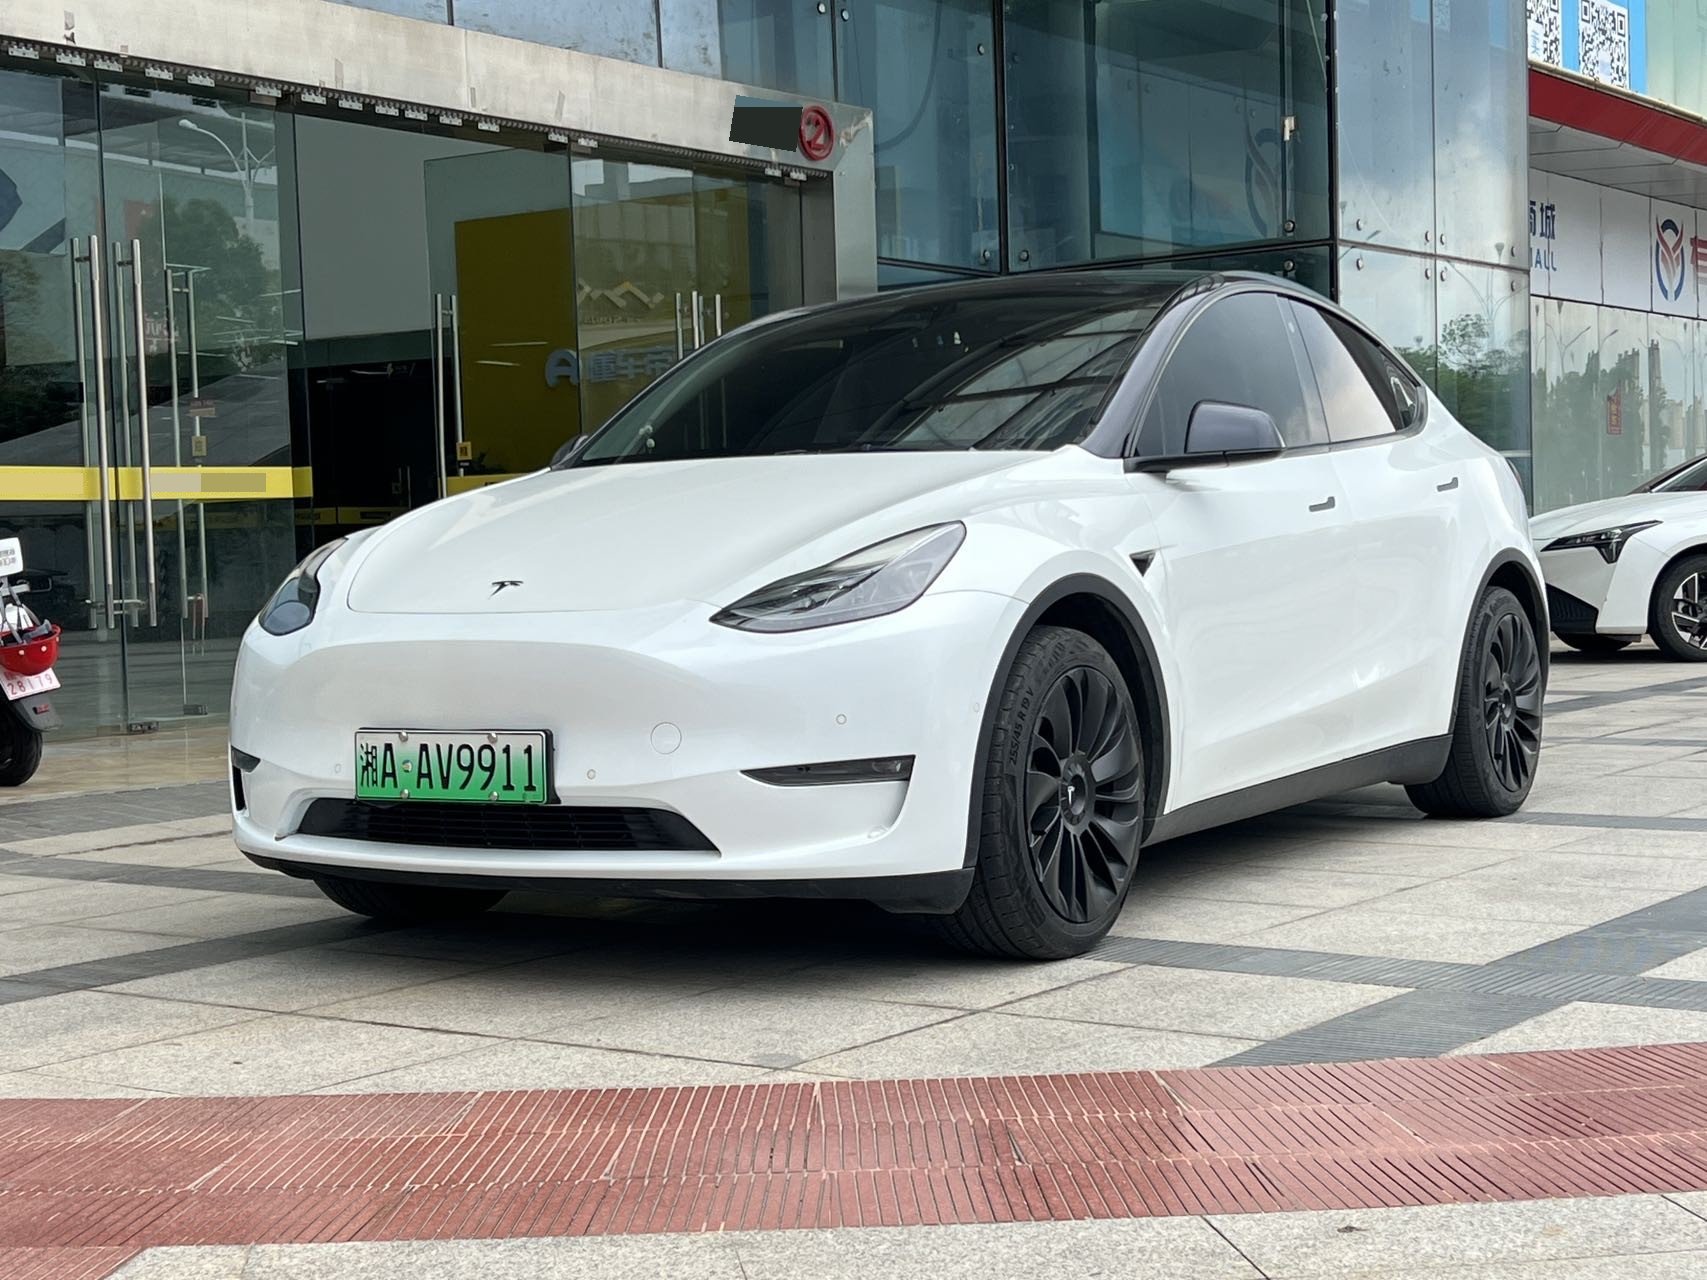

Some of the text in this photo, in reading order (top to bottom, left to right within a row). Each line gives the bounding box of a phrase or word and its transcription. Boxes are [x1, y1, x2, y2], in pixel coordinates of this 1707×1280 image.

[1530, 248, 1557, 272] ALL
[1020, 697, 1032, 711] 19
[1017, 711, 1027, 720] R
[1008, 723, 1024, 766] 255/45
